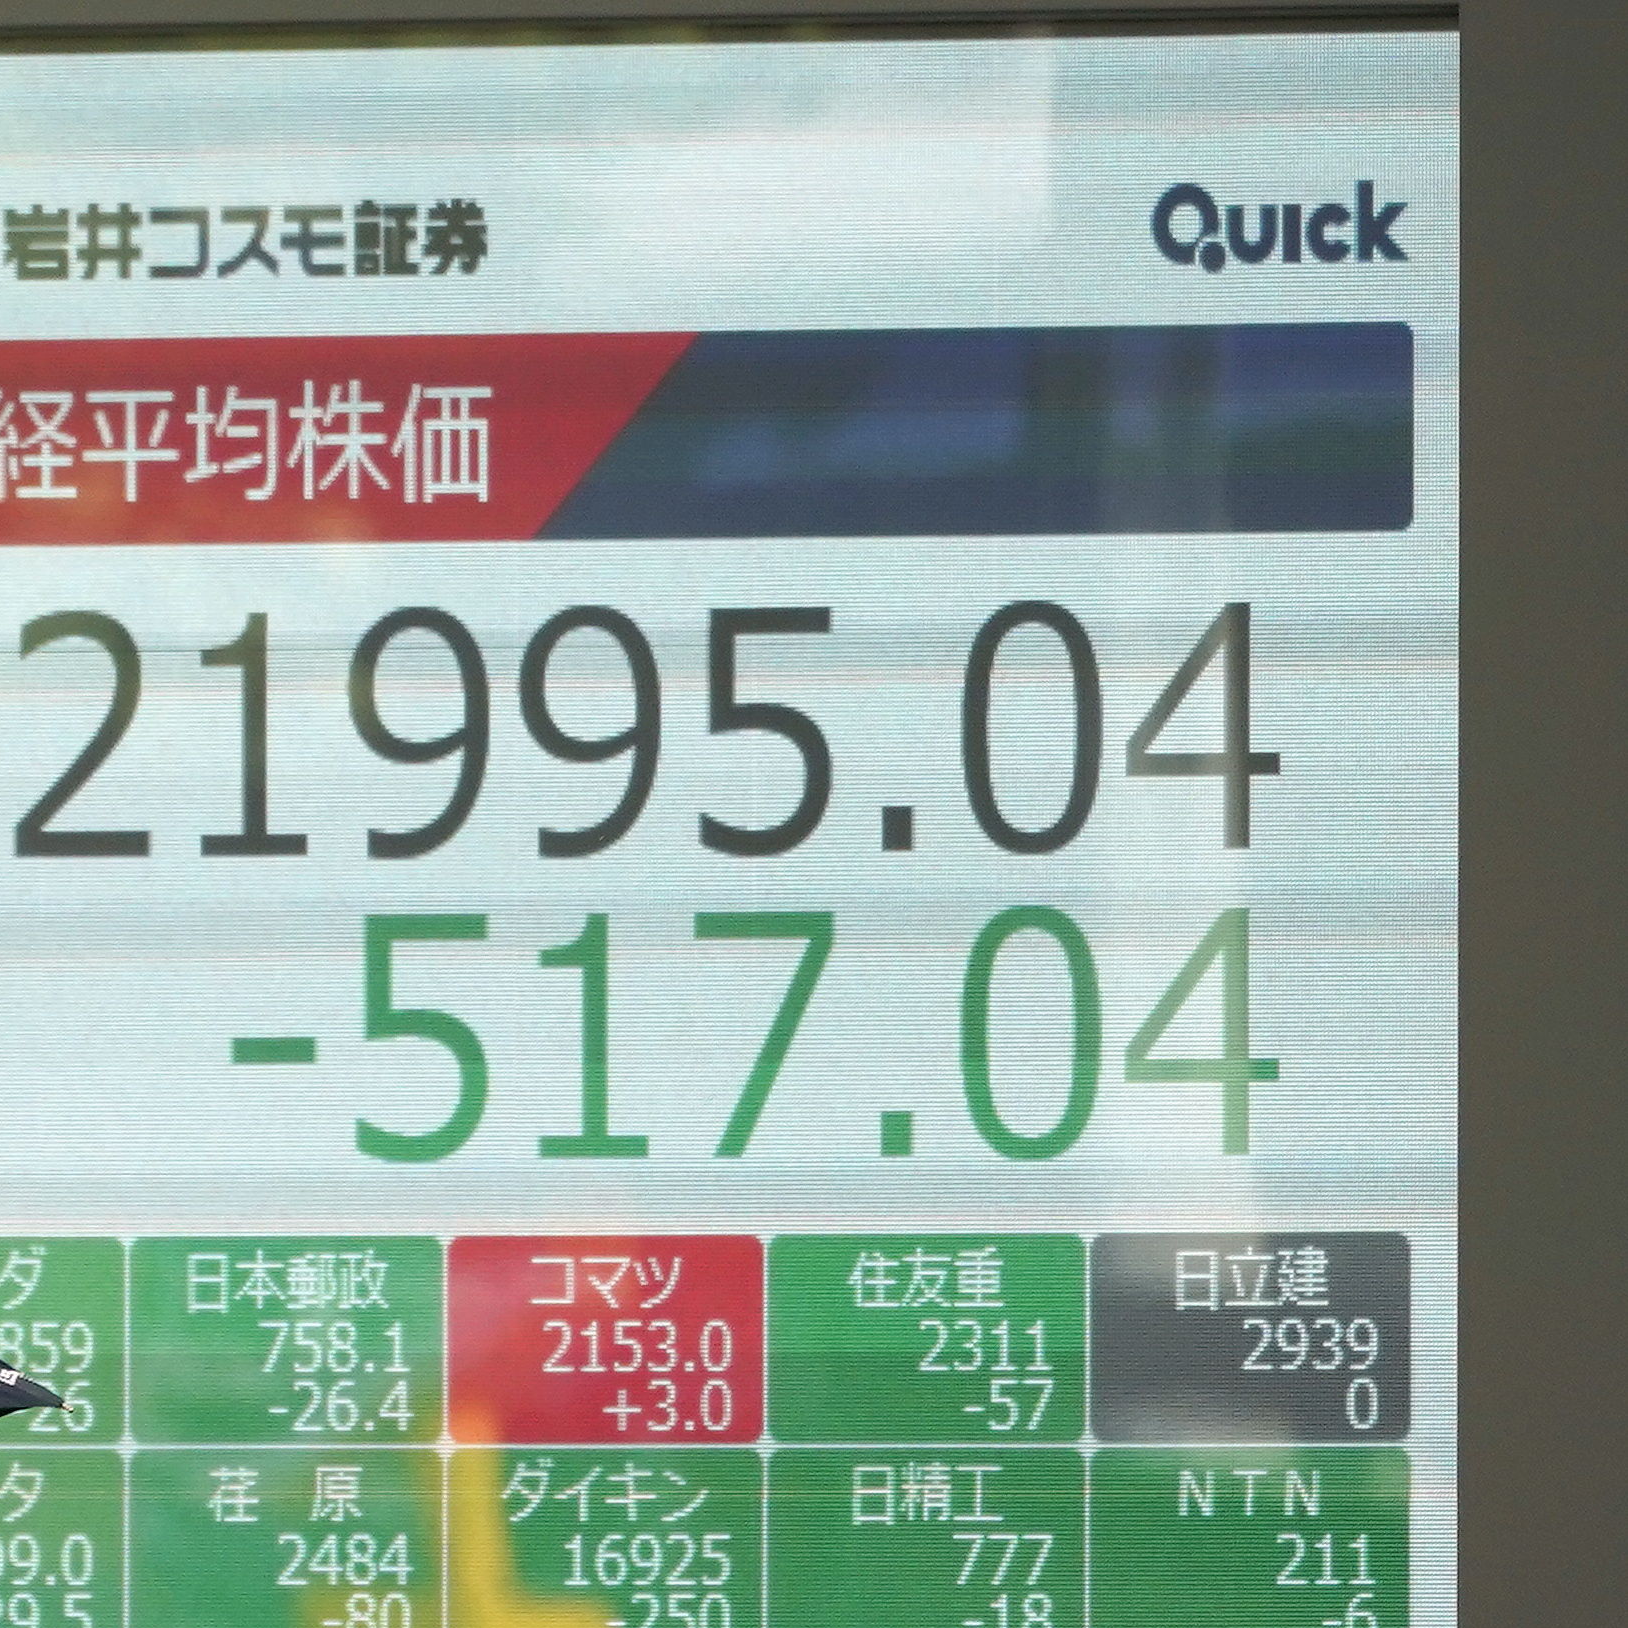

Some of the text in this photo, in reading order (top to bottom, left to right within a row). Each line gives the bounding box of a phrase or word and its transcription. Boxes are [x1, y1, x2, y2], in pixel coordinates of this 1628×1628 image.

[1, 199, 488, 283] 岩井コスモ証券
[13, 599, 1281, 859] 21995.04
[230, 904, 1281, 1162] -517.04
[530, 1256, 682, 1309] コマツ
[848, 1246, 1004, 1308] 住友重
[1175, 1245, 1329, 1311] 日立建
[543, 1319, 732, 1373] 2153.0
[919, 1318, 1052, 1372] 2311
[1242, 1317, 1378, 1371] 2939
[603, 1378, 733, 1432] +3.0
[963, 1377, 1054, 1431] -57
[1345, 1377, 1378, 1430] 0
[501, 1458, 708, 1523] ダイキン
[852, 1462, 1004, 1525] 日精工
[564, 1532, 730, 1587] 16925
